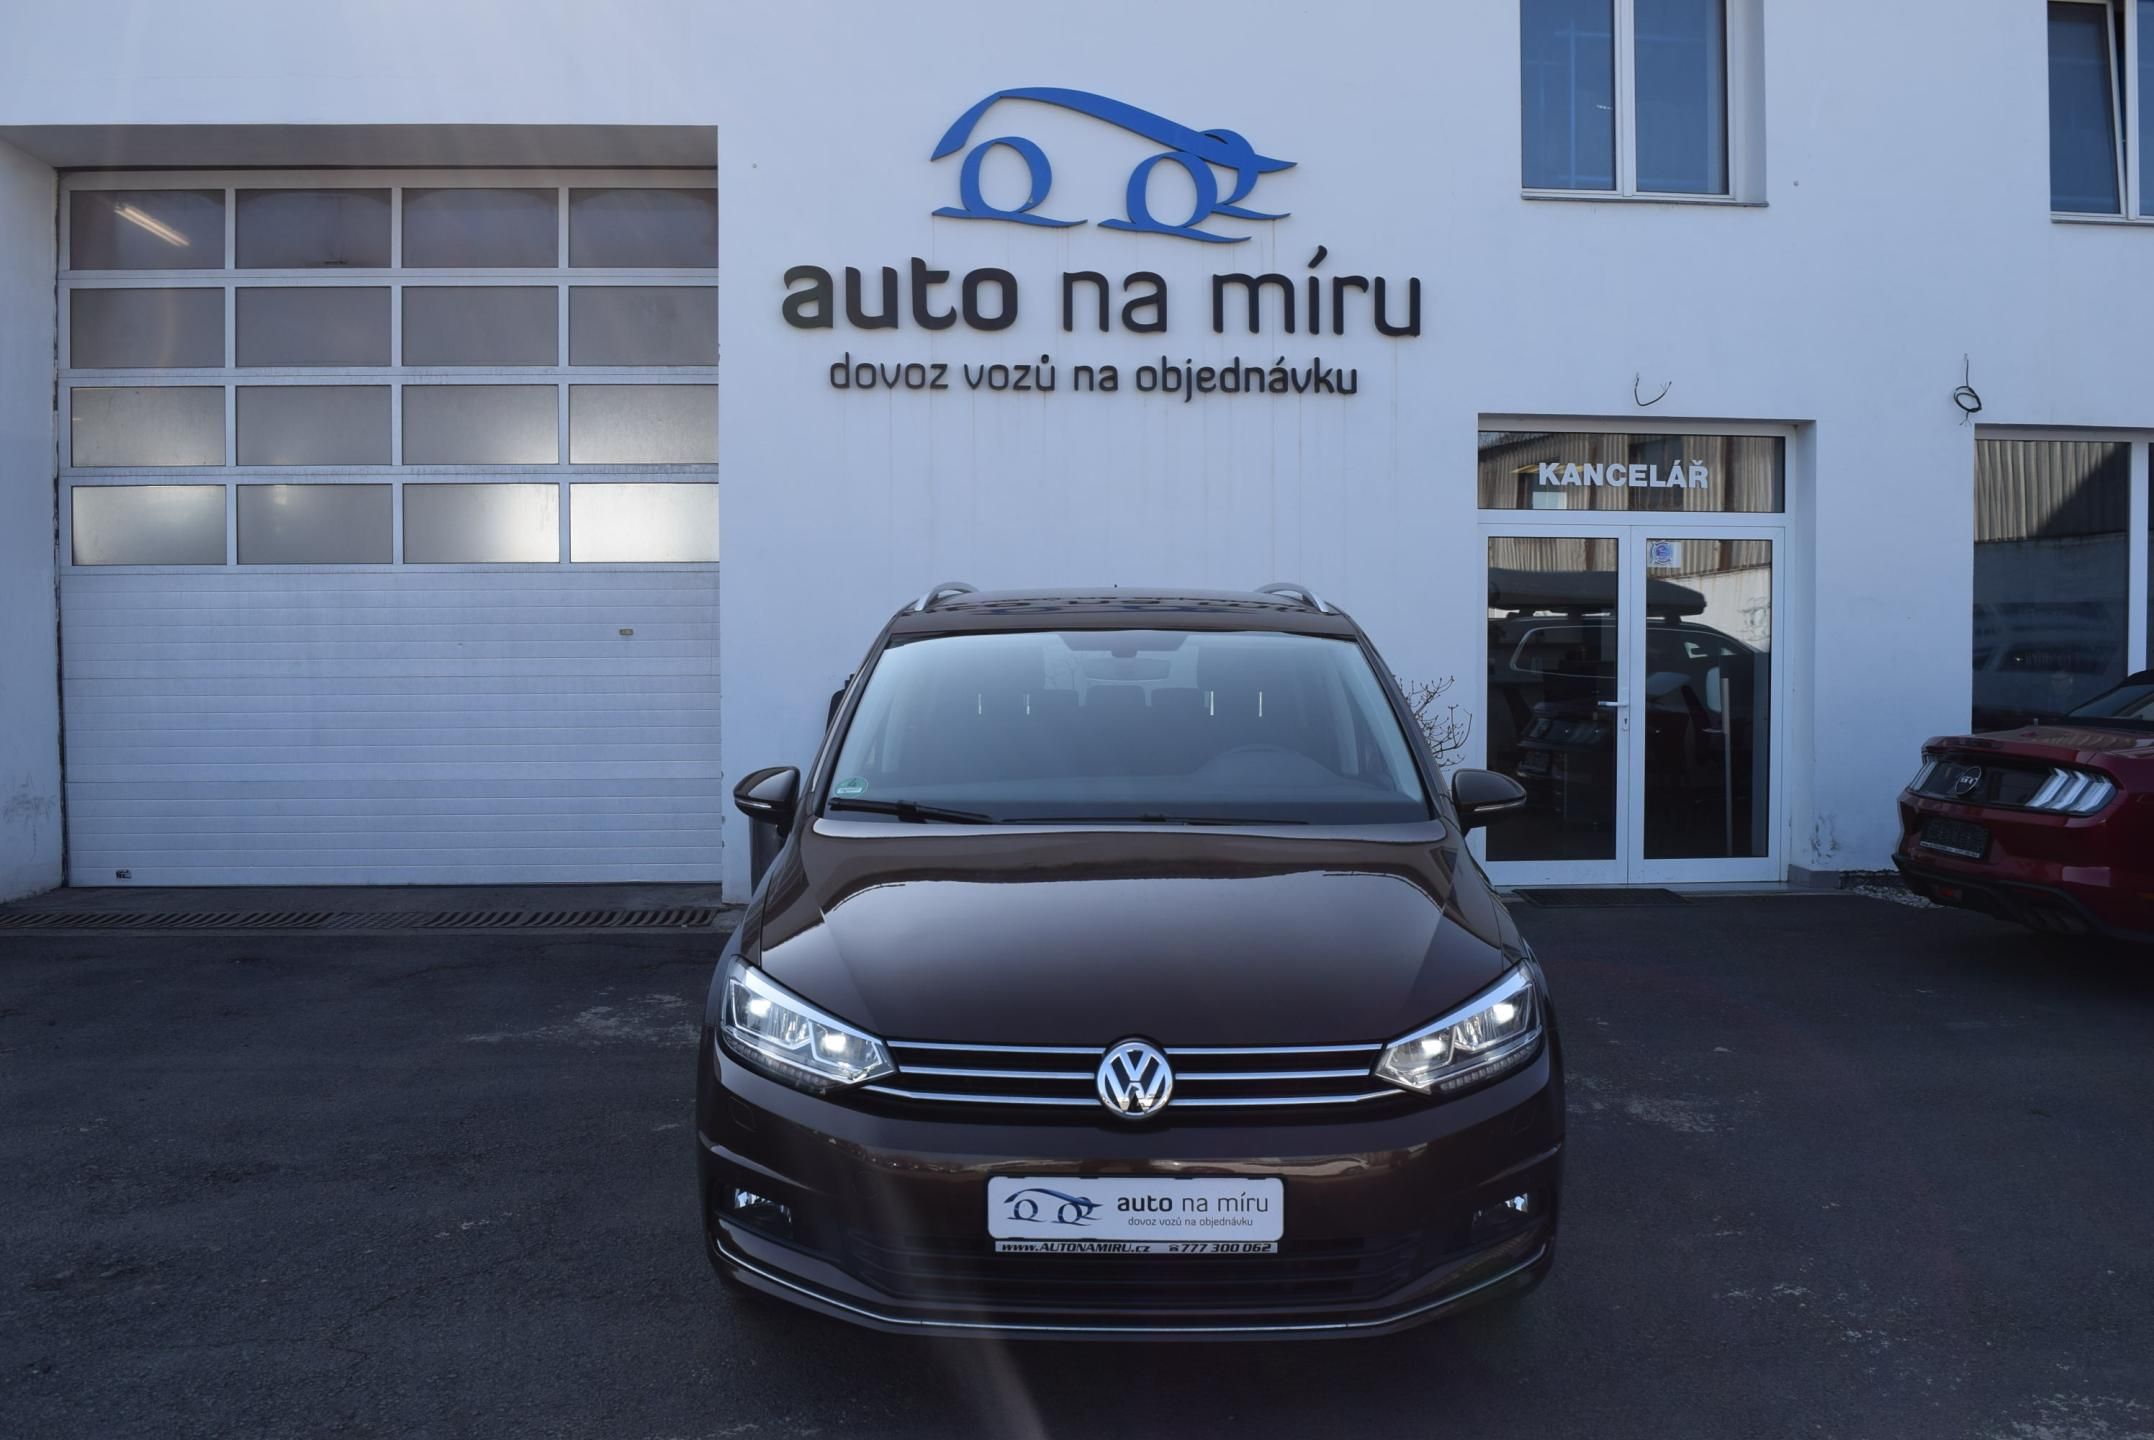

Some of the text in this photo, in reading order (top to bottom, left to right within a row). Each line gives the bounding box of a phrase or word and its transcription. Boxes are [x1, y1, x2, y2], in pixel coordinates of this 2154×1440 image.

[781, 245, 1422, 337] auto na míru
[829, 352, 1358, 403] dovoz vozů na objednávku
[1538, 459, 1709, 489] KANCELÁŘ
[1117, 1191, 1269, 1213] auto na míru
[1128, 1215, 1254, 1229] dovoz vozů na objednávku
[1181, 1242, 1207, 1253] 777
[1210, 1242, 1240, 1253] 300
[1242, 1242, 1272, 1253] 062
